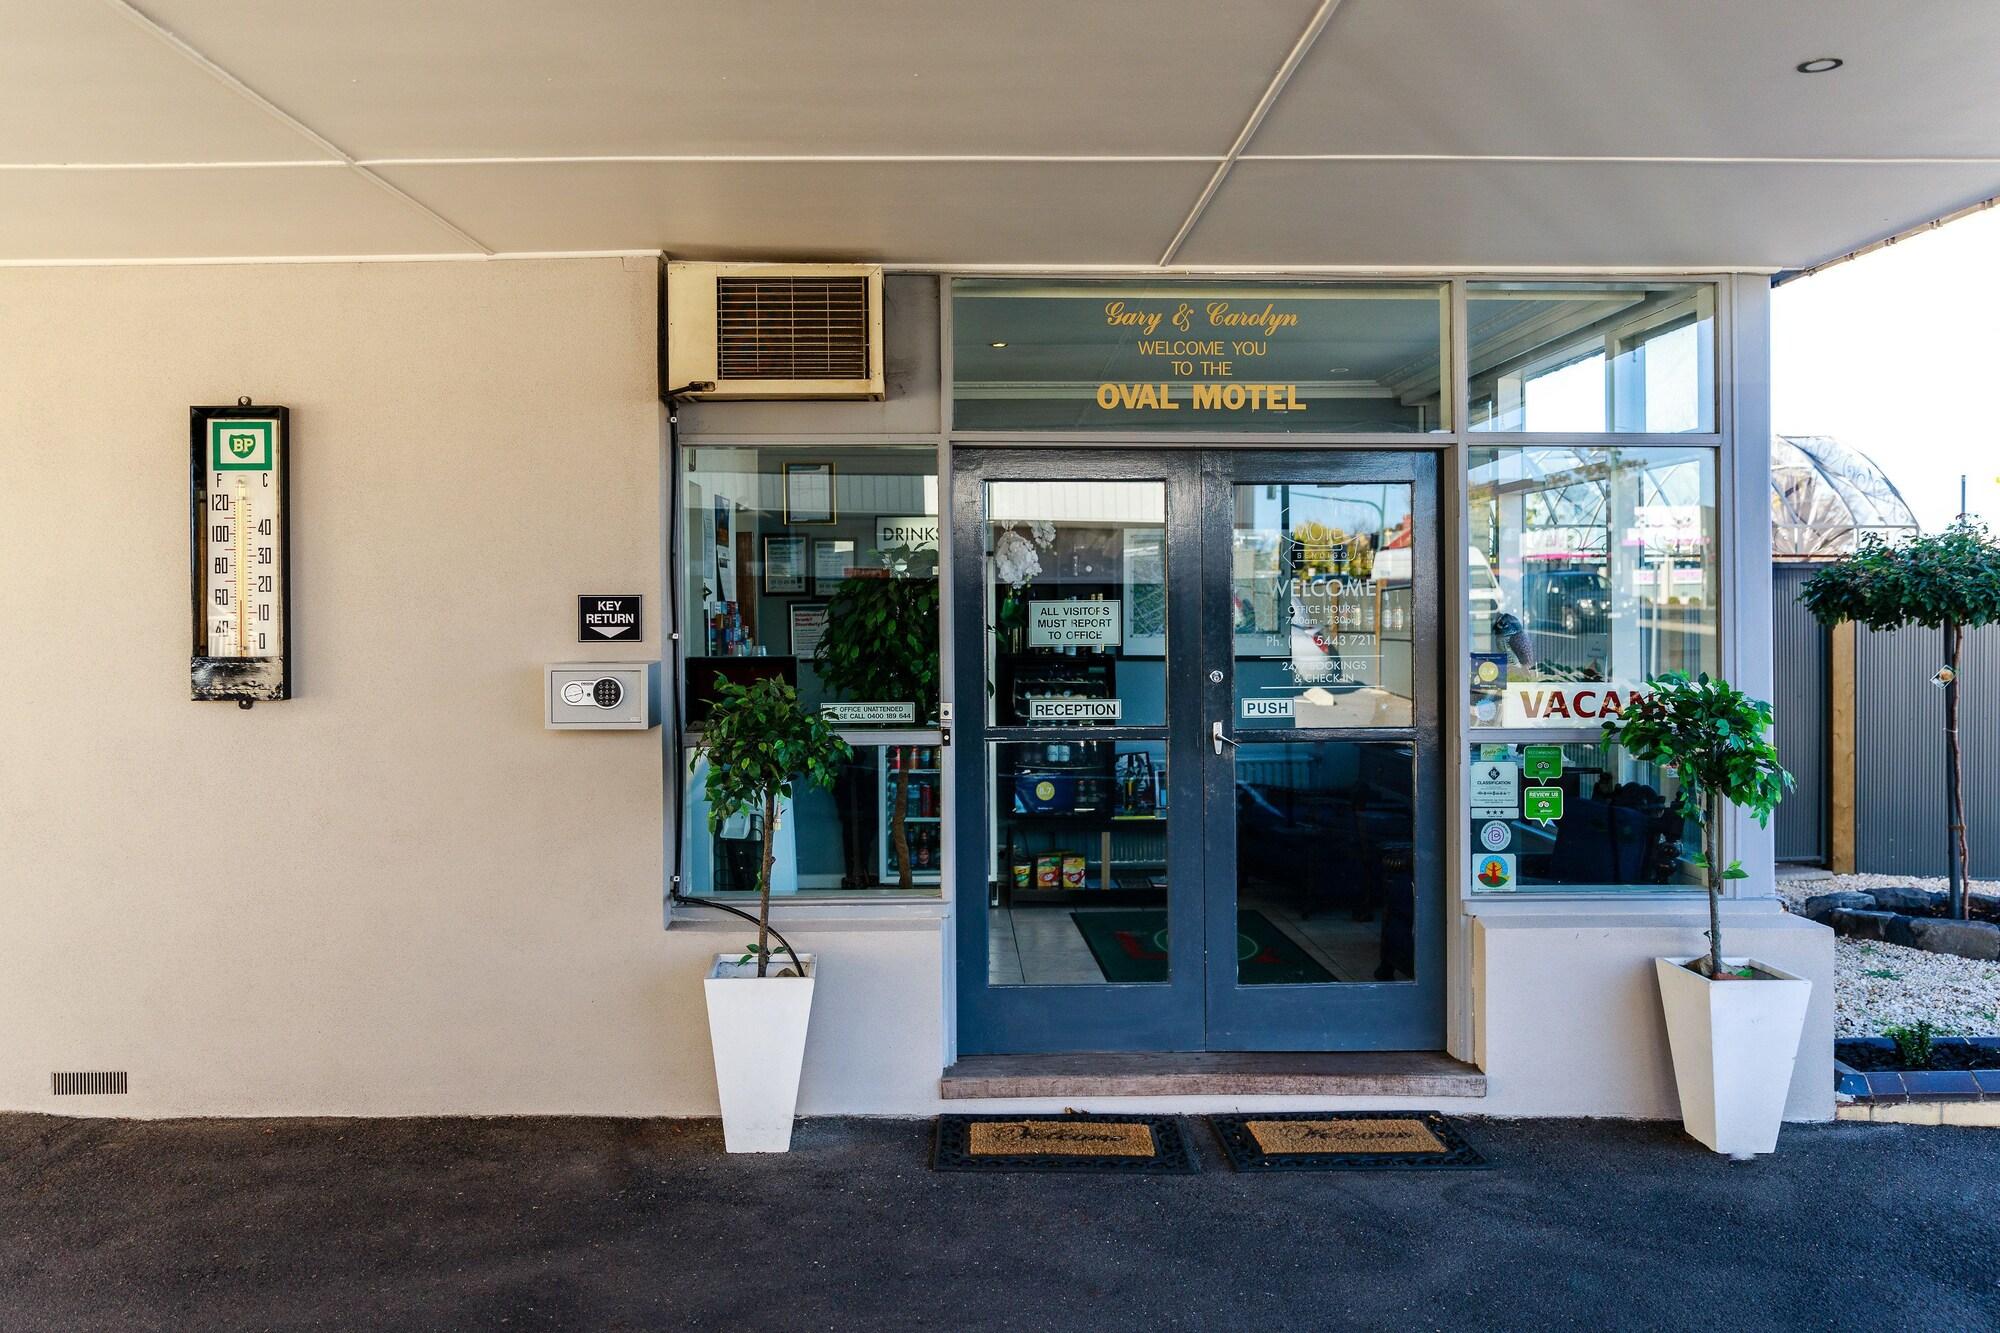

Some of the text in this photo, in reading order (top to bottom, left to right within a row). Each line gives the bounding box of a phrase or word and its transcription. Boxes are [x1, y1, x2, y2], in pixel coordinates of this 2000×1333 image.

[1105, 301, 1299, 337] Gary & Carolyn
[1137, 340, 1267, 356] WELCOME YOU
[1170, 361, 1233, 376] TO THE
[1096, 382, 1307, 411] OVAL MOTEL
[232, 437, 255, 454] BP
[216, 473, 223, 489] F
[262, 472, 269, 488] C
[211, 494, 230, 511] 120
[211, 525, 230, 543] 100
[257, 518, 272, 536] 40
[257, 547, 272, 564] 30
[214, 557, 229, 574] 80
[257, 575, 272, 593] 20
[1268, 578, 1377, 598] WELCOME
[214, 588, 229, 606] 60
[258, 604, 270, 621] 10
[597, 600, 622, 611] KEY
[1040, 606, 1110, 616] ALL VISITORS
[1287, 605, 1321, 614] OFICE
[585, 613, 635, 624] RETURN
[1037, 618, 1112, 628] MUST REPORT
[258, 632, 266, 650] 0
[1048, 630, 1102, 640] TO OFFICE
[1316, 635, 1346, 647] 5443
[1349, 634, 1377, 646] 7211
[1294, 673, 1302, 683] &
[839, 705, 861, 713] OFFICE
[863, 705, 904, 713] UNATTENDED
[1035, 703, 1116, 716] RECEPTION
[1247, 702, 1288, 714] PUSH
[1519, 690, 1668, 719] VACAN
[849, 712, 866, 720] CALL
[867, 712, 884, 720] 0400
[886, 712, 897, 720] 189
